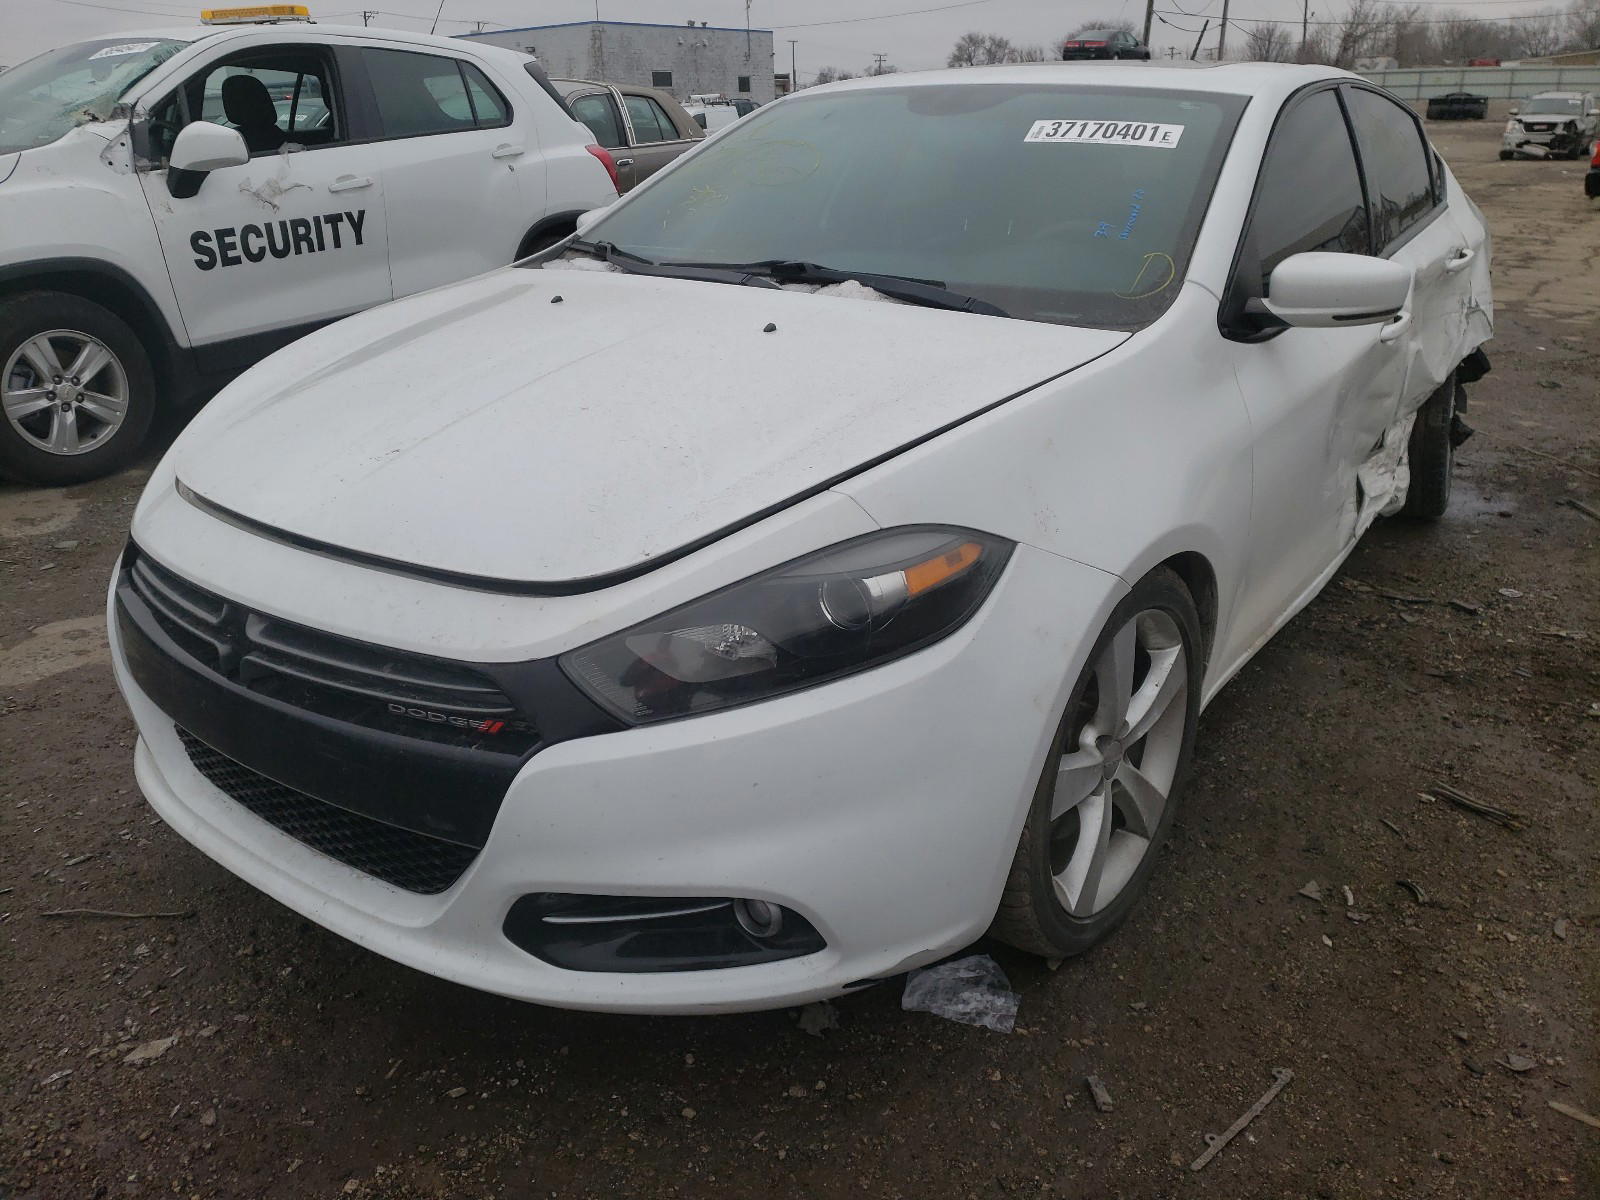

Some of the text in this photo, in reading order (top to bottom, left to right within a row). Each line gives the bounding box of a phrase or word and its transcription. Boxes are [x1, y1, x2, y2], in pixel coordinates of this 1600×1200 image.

[1045, 121, 1160, 142] 37170401
[190, 209, 366, 271] SECURITY
[387, 703, 489, 730] DODGE
